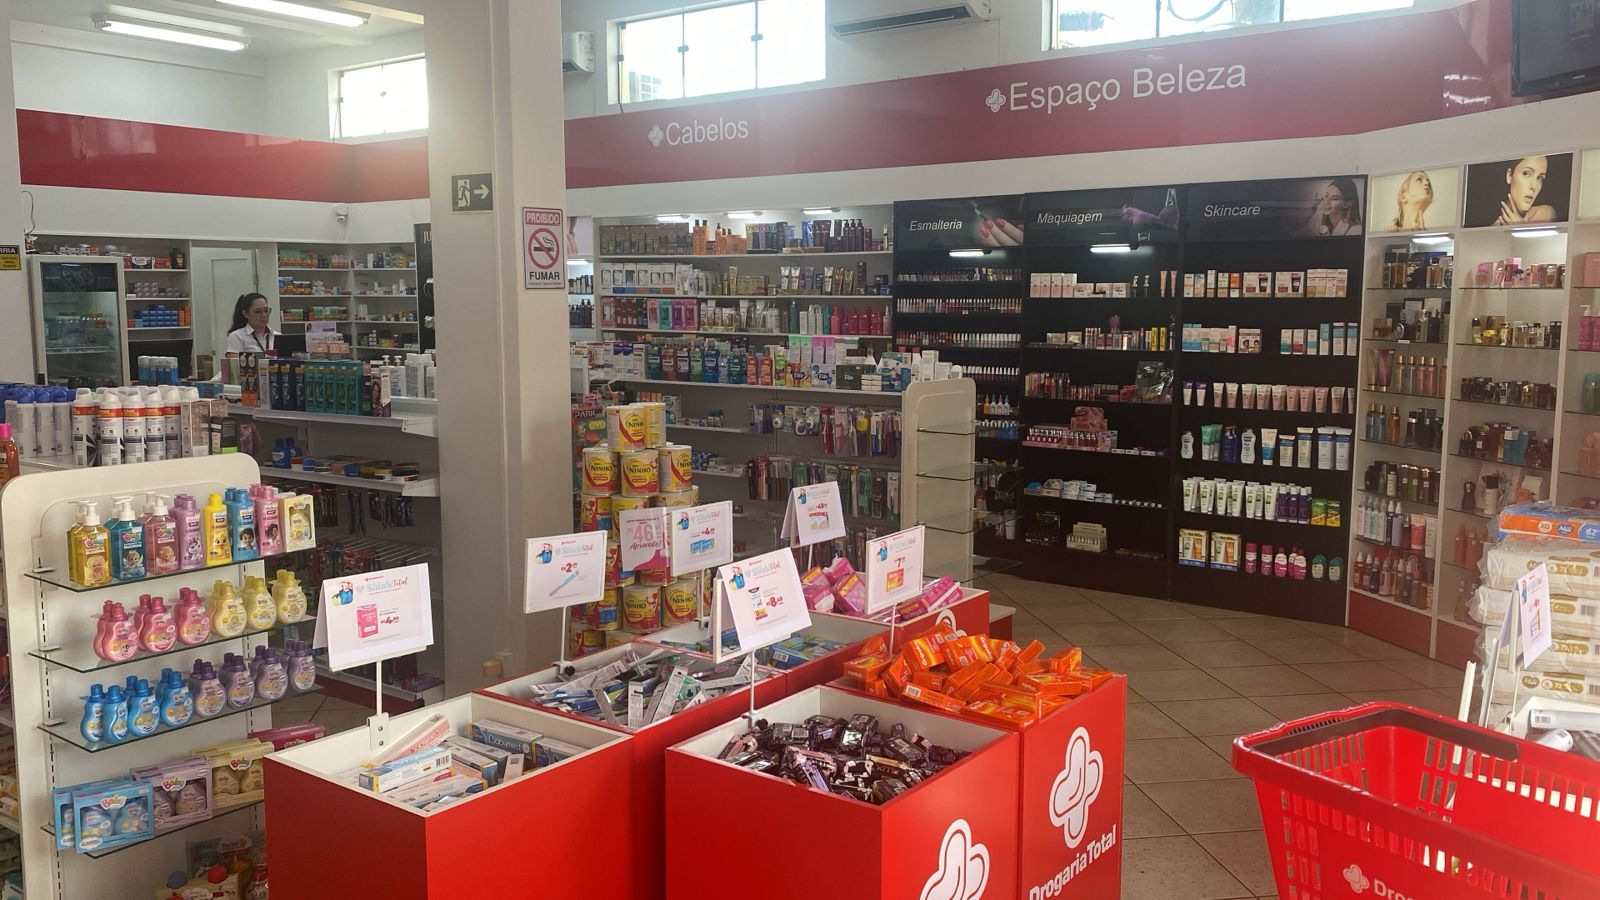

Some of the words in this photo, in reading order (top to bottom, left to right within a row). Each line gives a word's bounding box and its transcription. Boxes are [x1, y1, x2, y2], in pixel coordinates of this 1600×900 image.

[1010, 75, 1120, 113] Espaço
[1132, 61, 1247, 99] Beleza
[666, 116, 749, 147] Cabelos
[1203, 204, 1261, 218] Skincare
[526, 213, 560, 225] PROIBIDO
[909, 217, 963, 232] Esmalteria
[1036, 211, 1103, 227] Maquiagem
[529, 271, 560, 281] FUMAR
[590, 465, 613, 473] NINHO
[628, 465, 651, 474] NINHO
